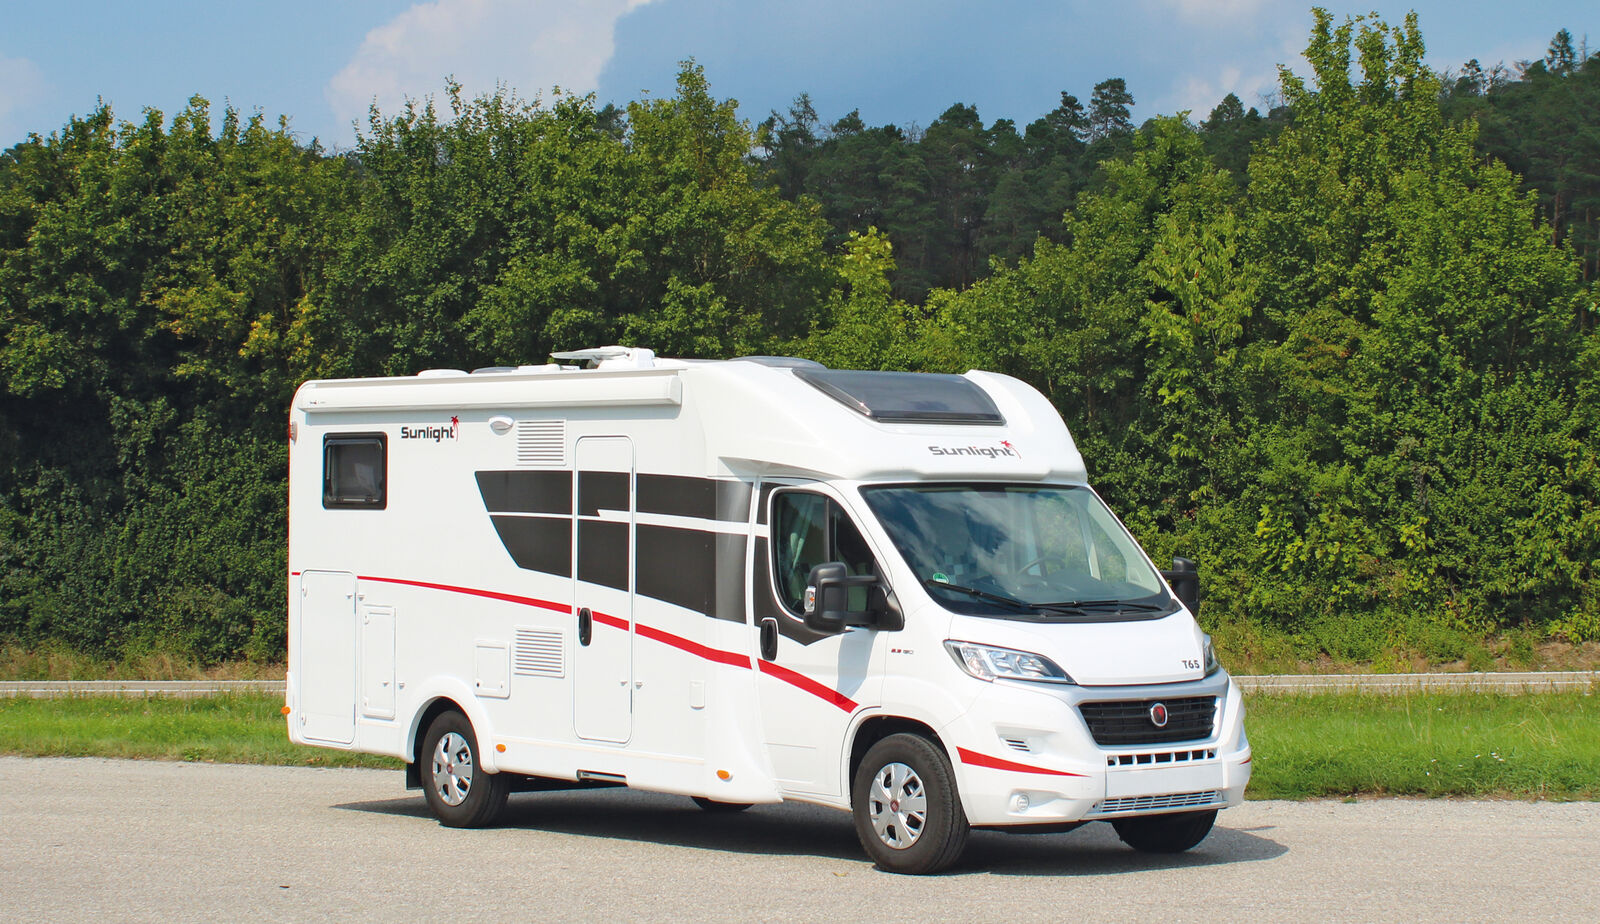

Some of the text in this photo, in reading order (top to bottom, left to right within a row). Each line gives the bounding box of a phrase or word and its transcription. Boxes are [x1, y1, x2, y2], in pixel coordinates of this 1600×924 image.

[401, 426, 454, 442] Sunlight
[928, 446, 1015, 459] Sunlight
[1182, 660, 1200, 669] T65
